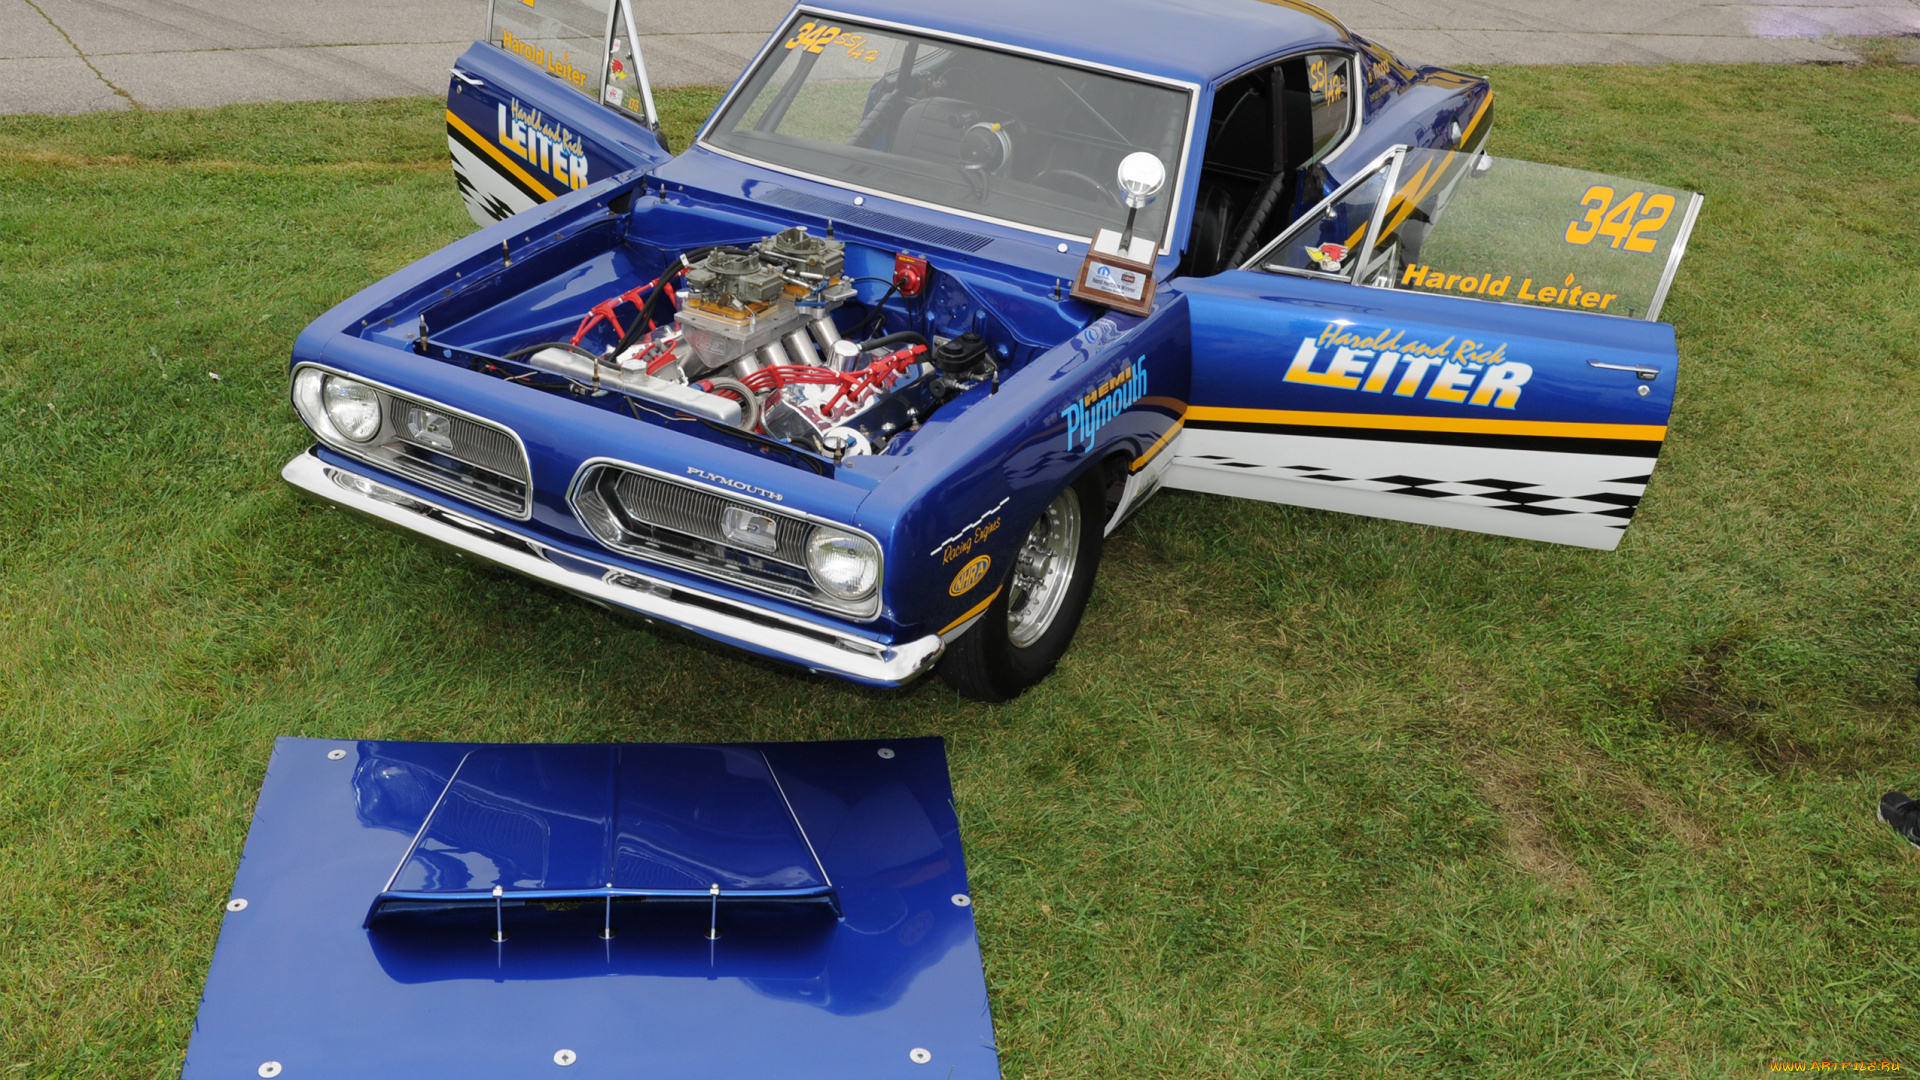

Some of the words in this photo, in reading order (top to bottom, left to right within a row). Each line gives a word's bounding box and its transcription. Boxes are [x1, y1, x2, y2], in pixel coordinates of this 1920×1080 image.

[503, 29, 544, 66] Harold
[548, 51, 587, 87] Leiter
[784, 22, 841, 54] 342
[498, 102, 588, 191] LEITER
[511, 97, 542, 130] Harold
[542, 122, 562, 143] and
[563, 127, 585, 157] Rick
[1564, 185, 1676, 254] 342
[1401, 263, 1511, 296] Harold
[1517, 272, 1617, 309] Leiter
[1318, 323, 1405, 350] Harold
[1401, 336, 1455, 357] and
[1453, 339, 1507, 365] Rick
[1084, 366, 1132, 408] HEMI
[1282, 337, 1533, 410] LEITER
[1061, 354, 1147, 453] Plymouth
[686, 466, 783, 501] PLYMOUTH
[942, 537, 972, 566] Racing
[974, 517, 1001, 543] Engines
[953, 560, 988, 592] NHRA
